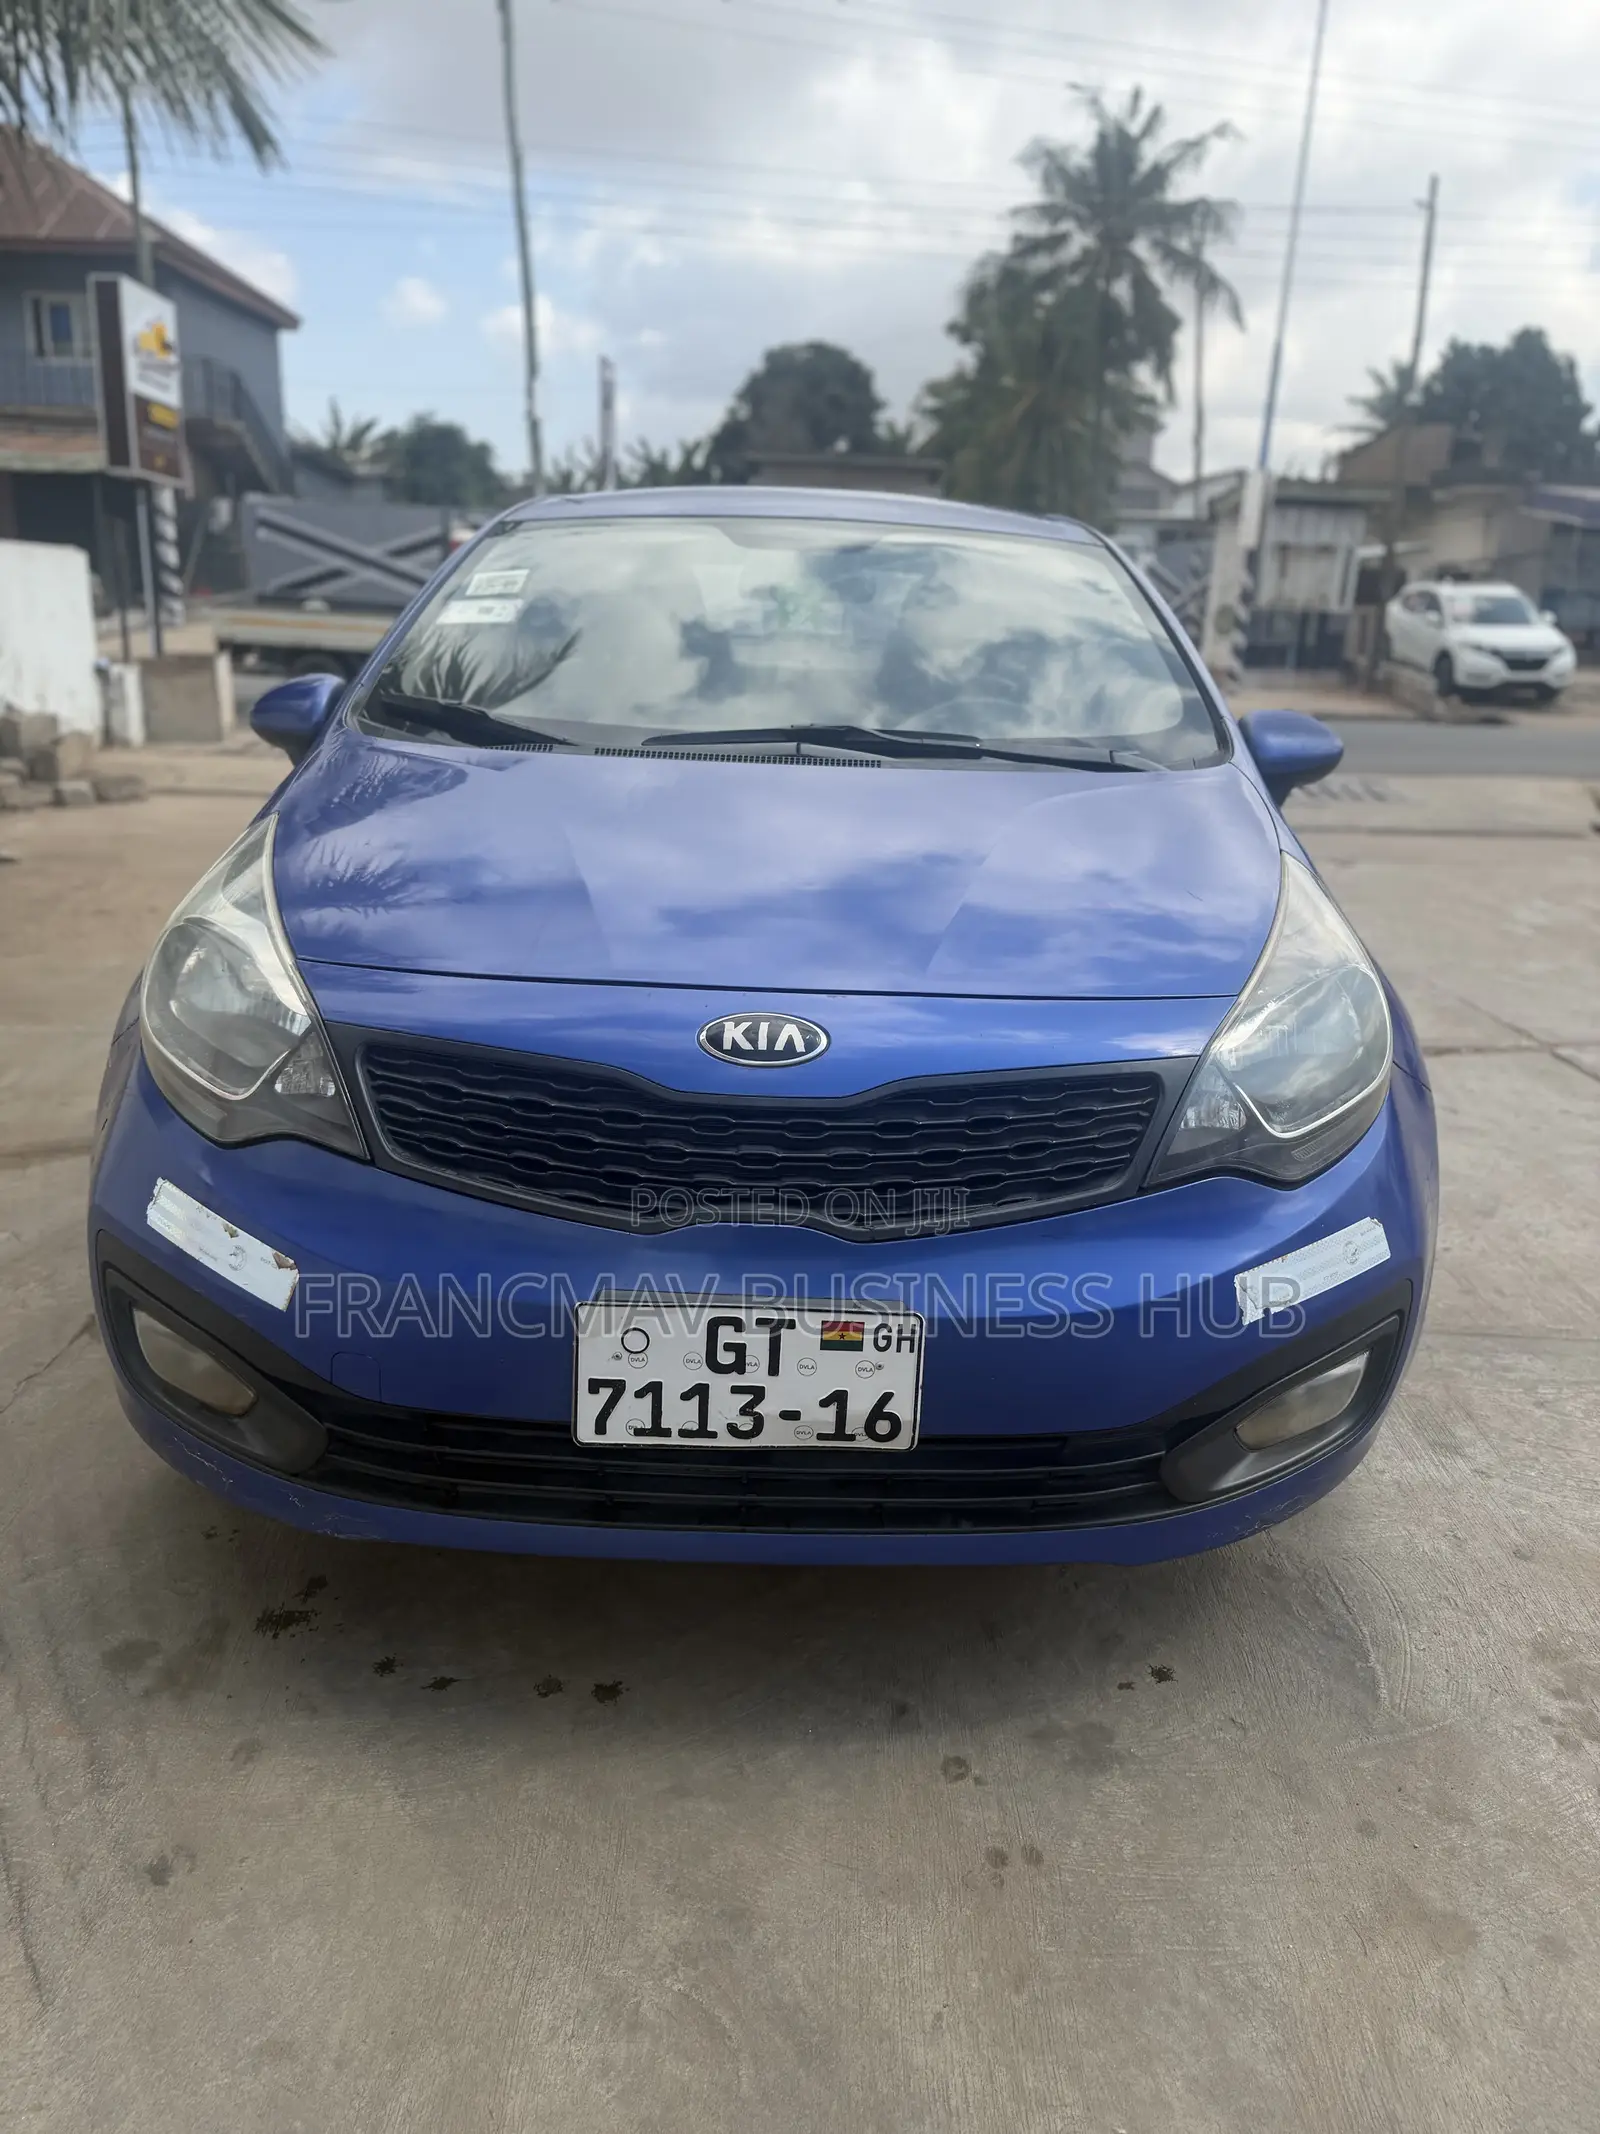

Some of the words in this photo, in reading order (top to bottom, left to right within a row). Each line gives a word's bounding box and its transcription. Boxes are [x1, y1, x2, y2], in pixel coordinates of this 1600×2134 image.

[723, 1021, 806, 1053] KIA
[704, 1315, 797, 1377] GT
[872, 1322, 916, 1354] GH
[587, 1377, 903, 1443] 7113-16
